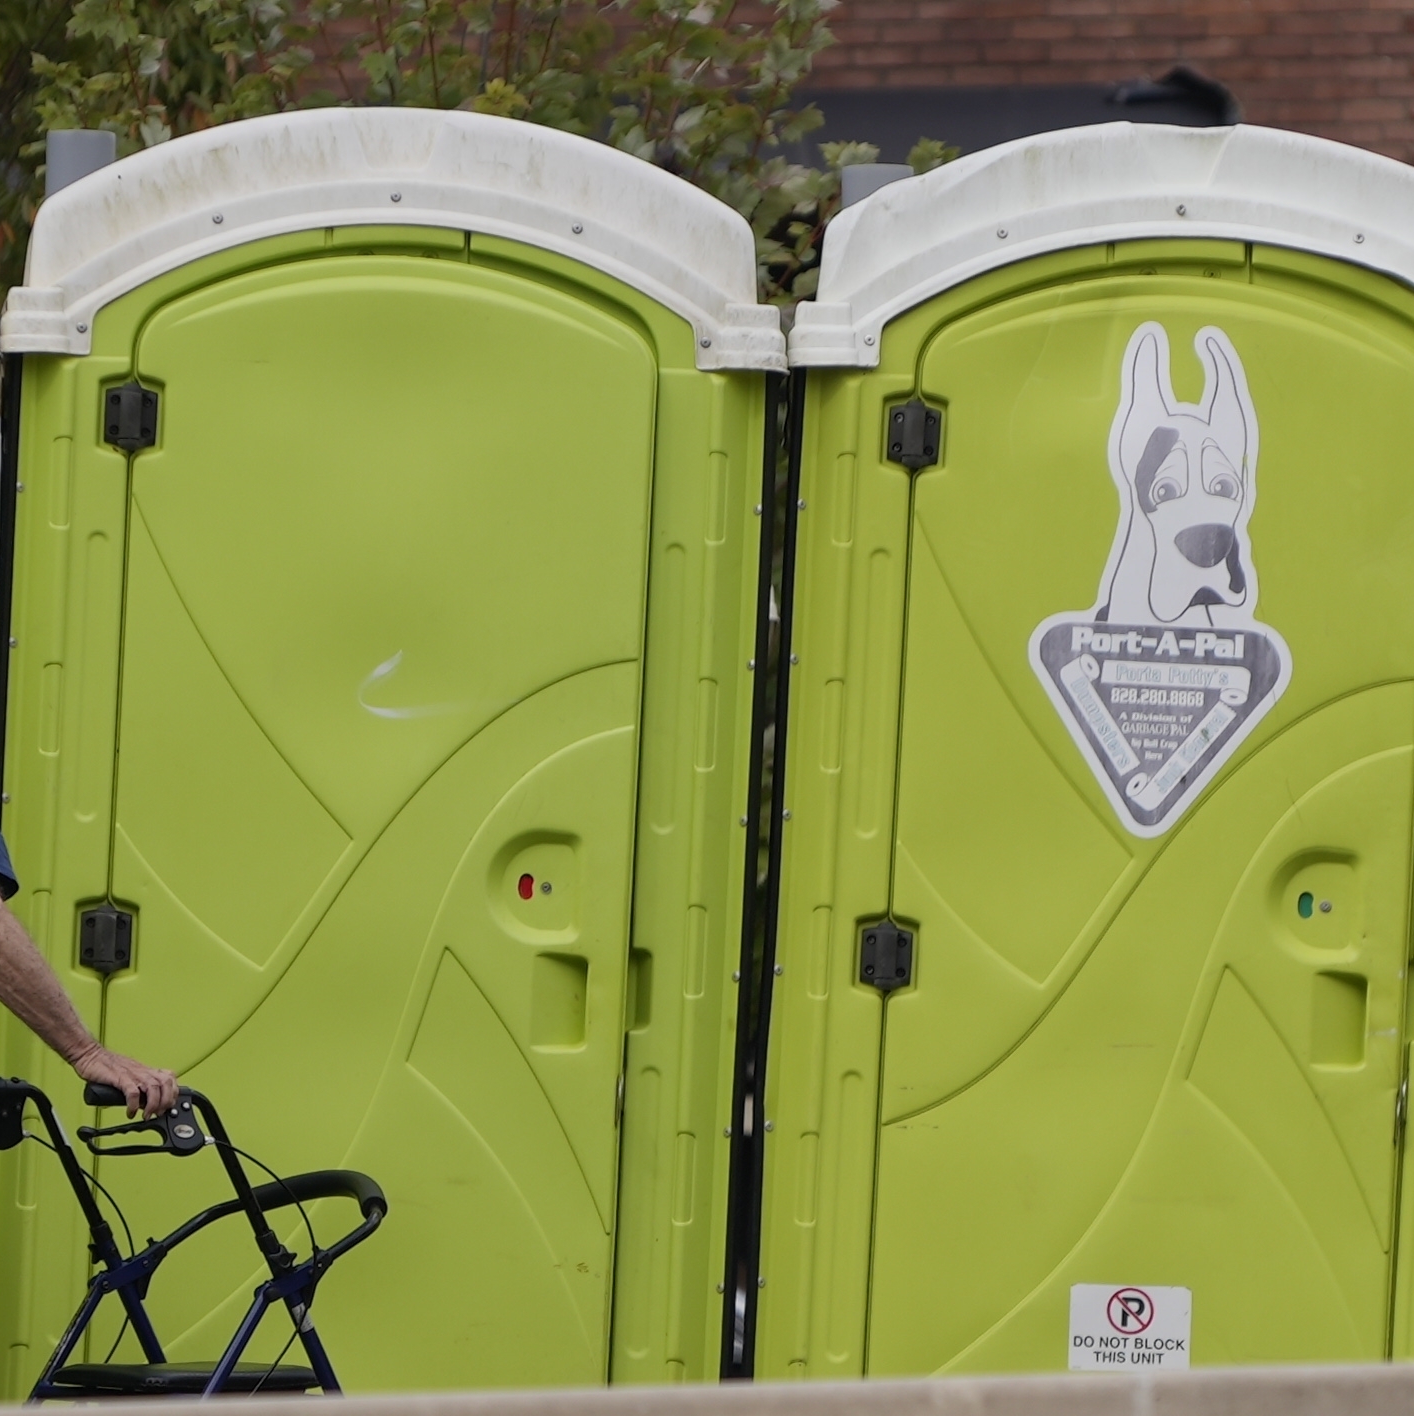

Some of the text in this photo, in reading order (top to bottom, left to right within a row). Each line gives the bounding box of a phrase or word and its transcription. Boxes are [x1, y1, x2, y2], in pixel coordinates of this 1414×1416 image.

[1071, 627, 1244, 659] Port-A-Pal
[1116, 665, 1161, 682] Porta
[1110, 689, 1205, 706] 828.280.8868
[1070, 677, 1131, 769] Dumpsters
[1119, 713, 1193, 723] A Division of
[1121, 722, 1188, 735] GARBAGE PAL
[1074, 1336, 1185, 1350] DO NOT BLOCK
[1094, 1351, 1165, 1364] THIS UNIT
